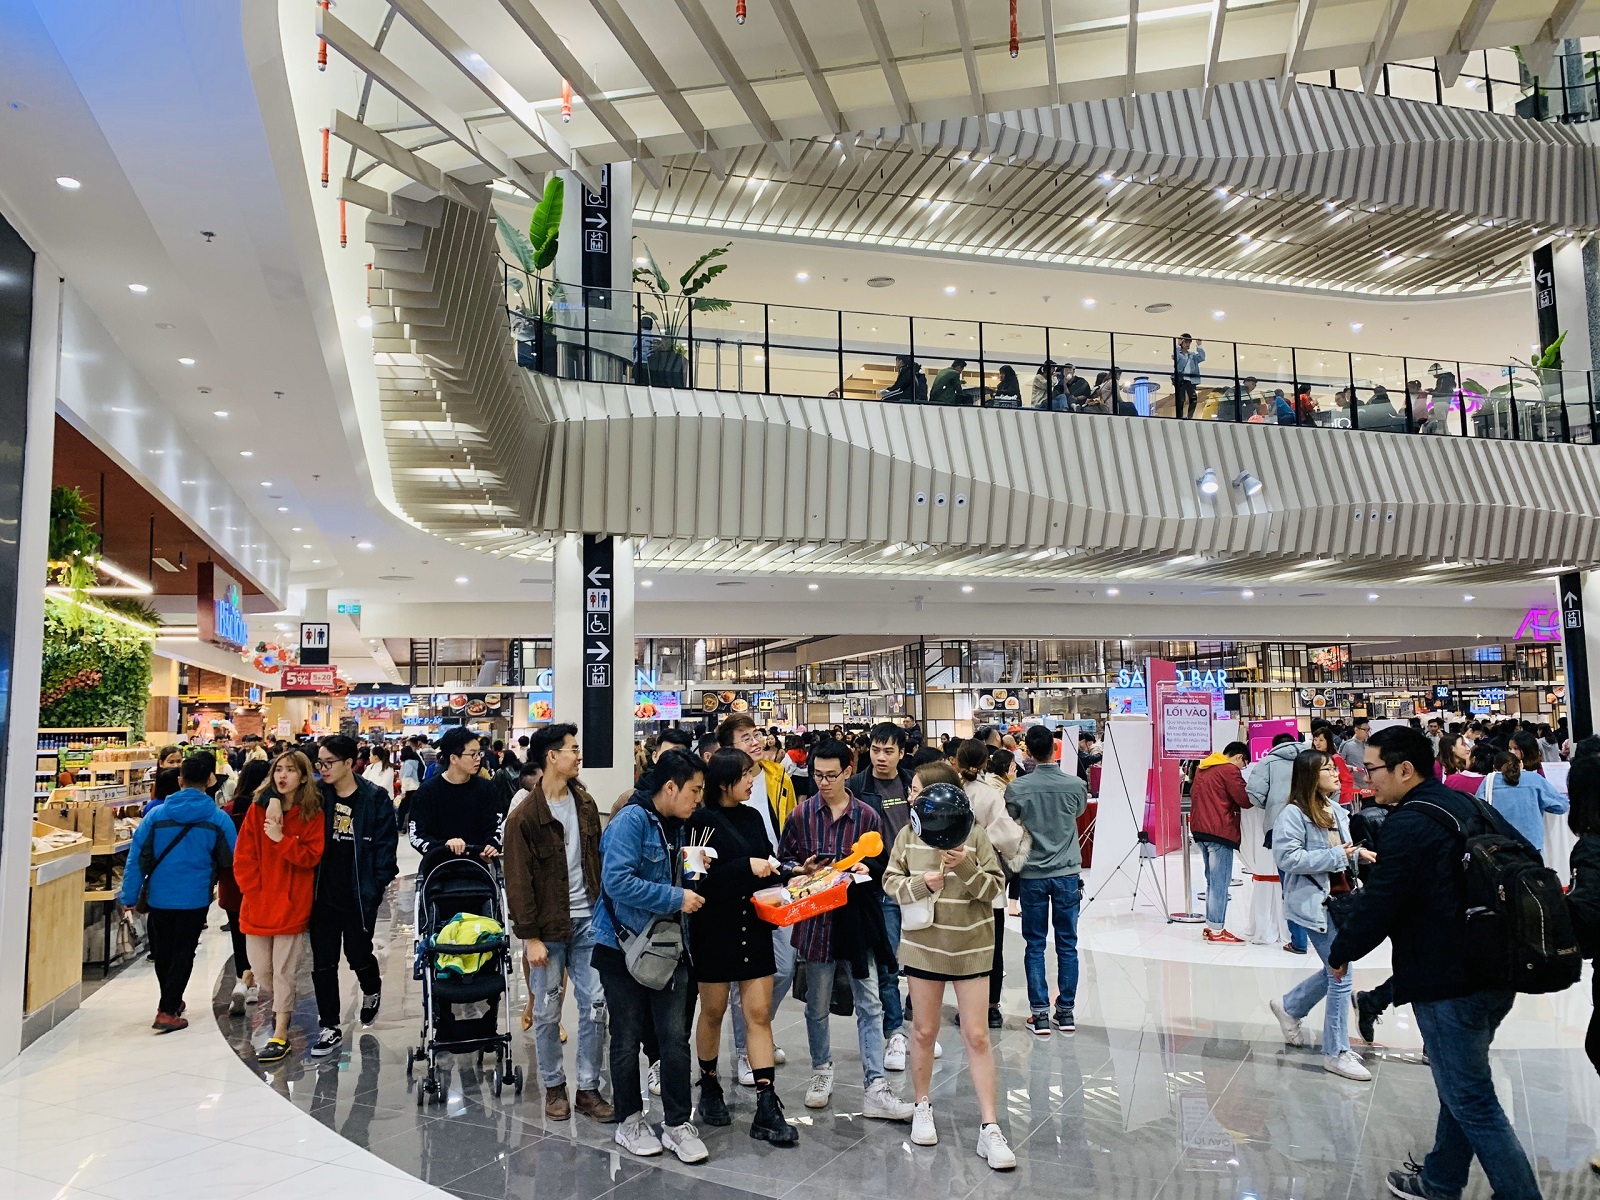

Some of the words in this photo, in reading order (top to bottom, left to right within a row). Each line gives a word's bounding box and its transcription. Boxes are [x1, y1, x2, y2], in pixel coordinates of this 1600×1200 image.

[1190, 668, 1228, 687] BAR
[347, 695, 412, 709] SUPER
[1166, 705, 1183, 717] LỐI
[1185, 706, 1207, 717] VÀO
